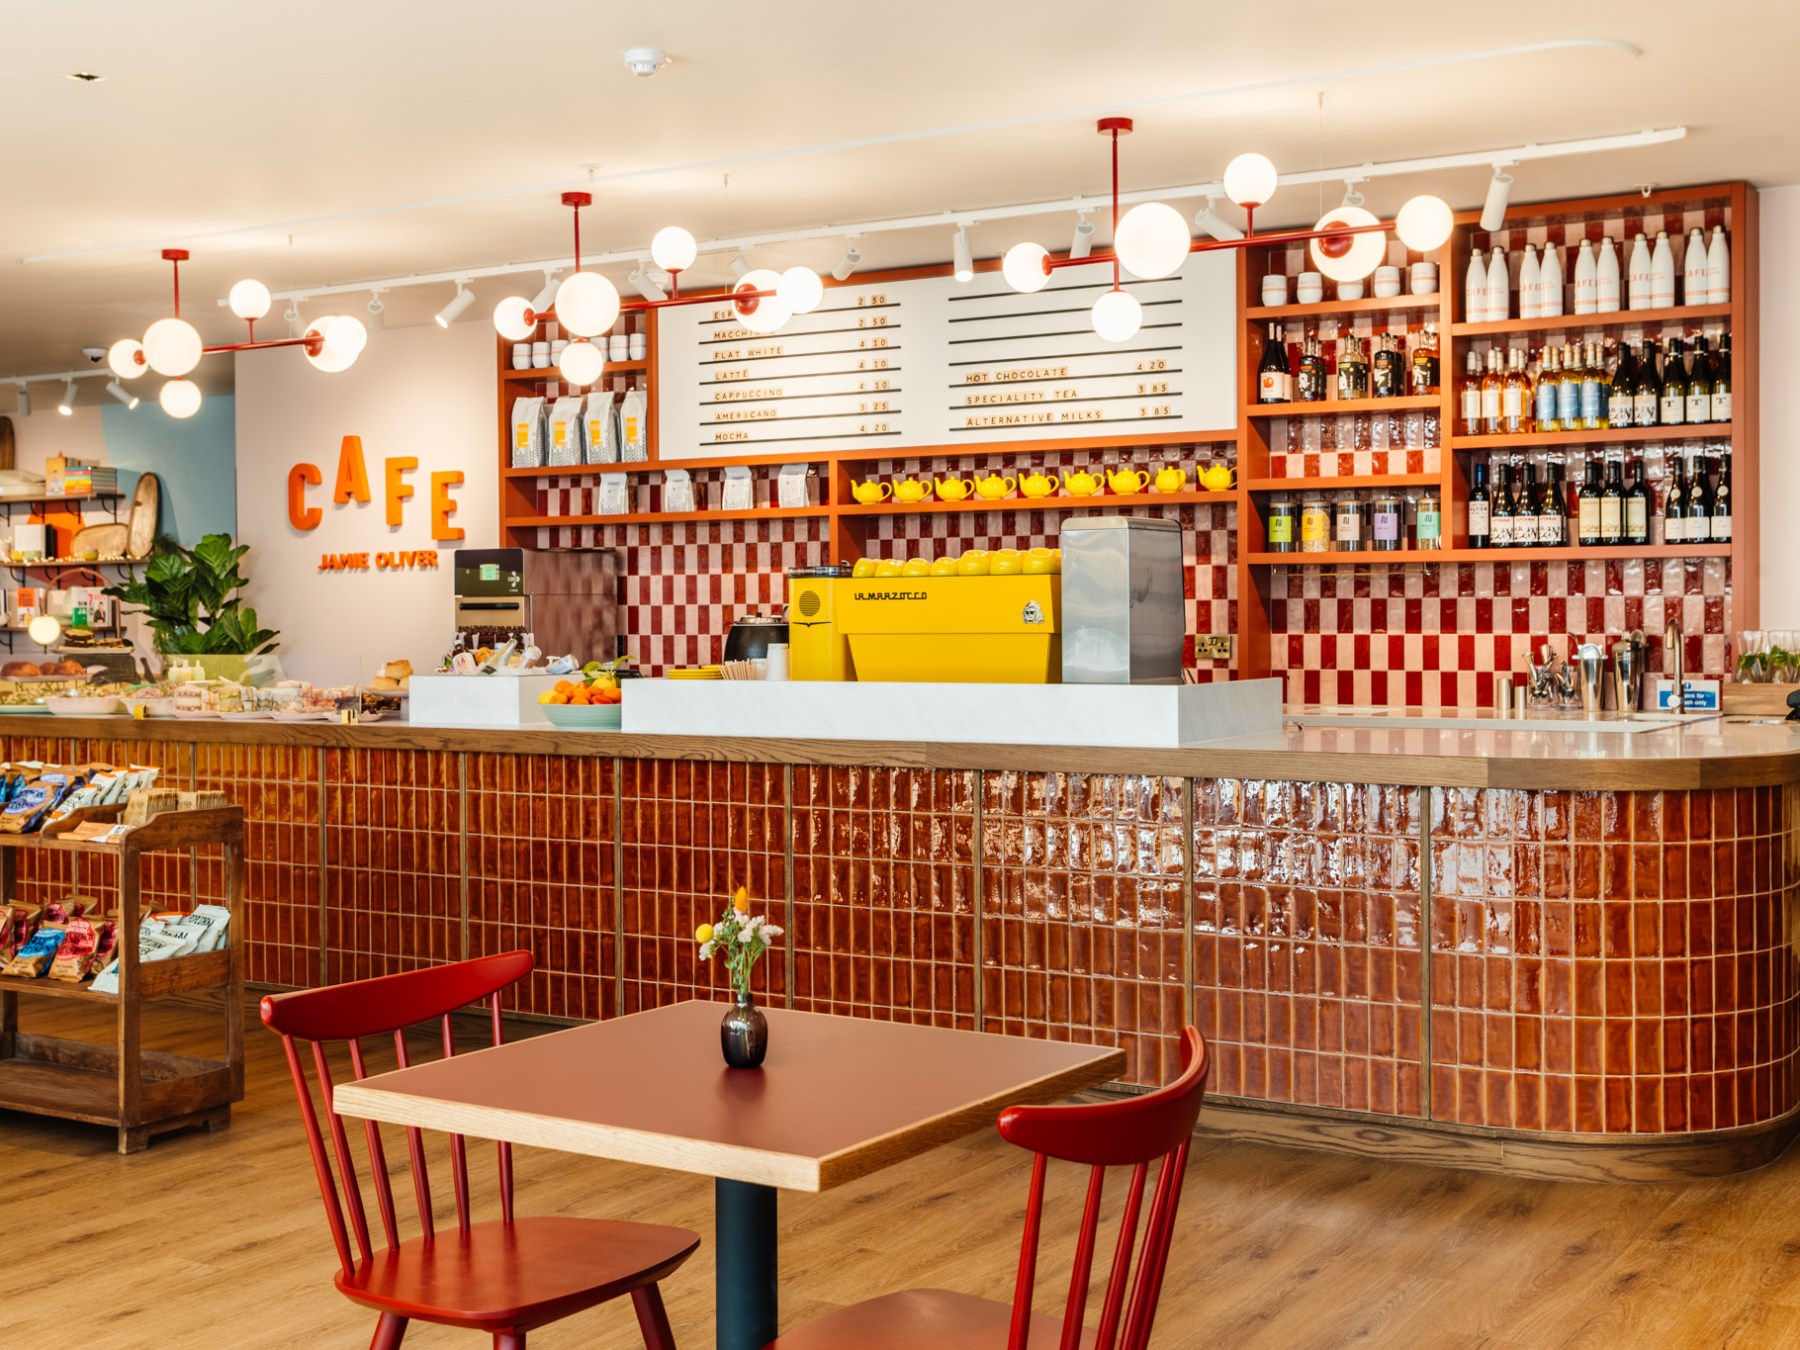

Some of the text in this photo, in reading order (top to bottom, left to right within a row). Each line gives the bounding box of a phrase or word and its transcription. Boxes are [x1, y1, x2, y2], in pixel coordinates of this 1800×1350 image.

[714, 330, 775, 339] MACCHI
[714, 351, 740, 359] FLAT
[748, 347, 782, 356] WHITE
[873, 339, 886, 347] 10
[715, 370, 748, 380] LATTE
[874, 360, 886, 368] 10
[966, 374, 988, 382] HOT
[996, 368, 1066, 380] CHOCOLATE
[1150, 361, 1165, 370] 20
[715, 389, 783, 400] CAPPUCCINO
[875, 381, 888, 389] 10
[967, 384, 1167, 404] SPECIALITY TEA 3 85
[716, 410, 777, 421] AMERICANO
[874, 402, 886, 410] 25
[967, 407, 1169, 426] ALTERNATIVE MILKS 3 85
[715, 432, 749, 441] MOCHA
[288, 435, 465, 540] CAFE
[318, 551, 438, 570] JAMIE OLIVER
